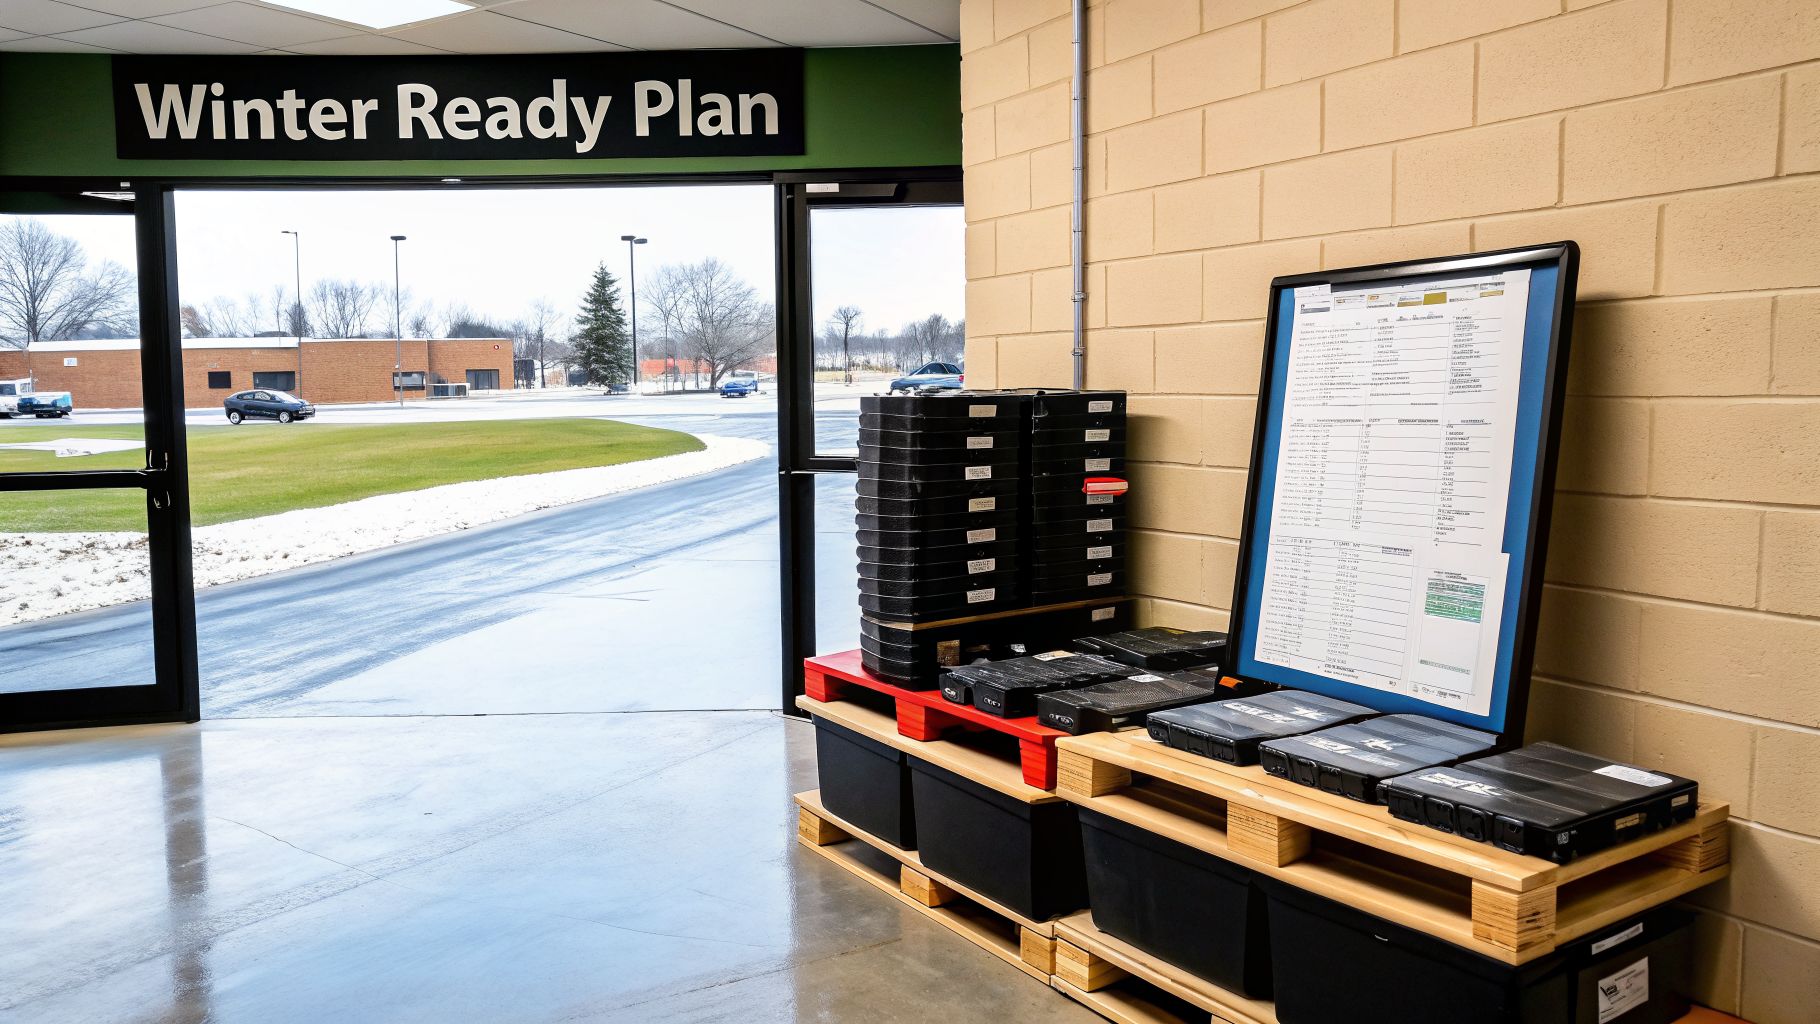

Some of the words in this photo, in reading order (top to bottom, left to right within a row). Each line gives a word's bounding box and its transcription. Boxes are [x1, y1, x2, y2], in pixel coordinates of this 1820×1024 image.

[134, 82, 379, 141] Winter
[396, 78, 612, 154] Ready
[634, 78, 779, 140] Plan
